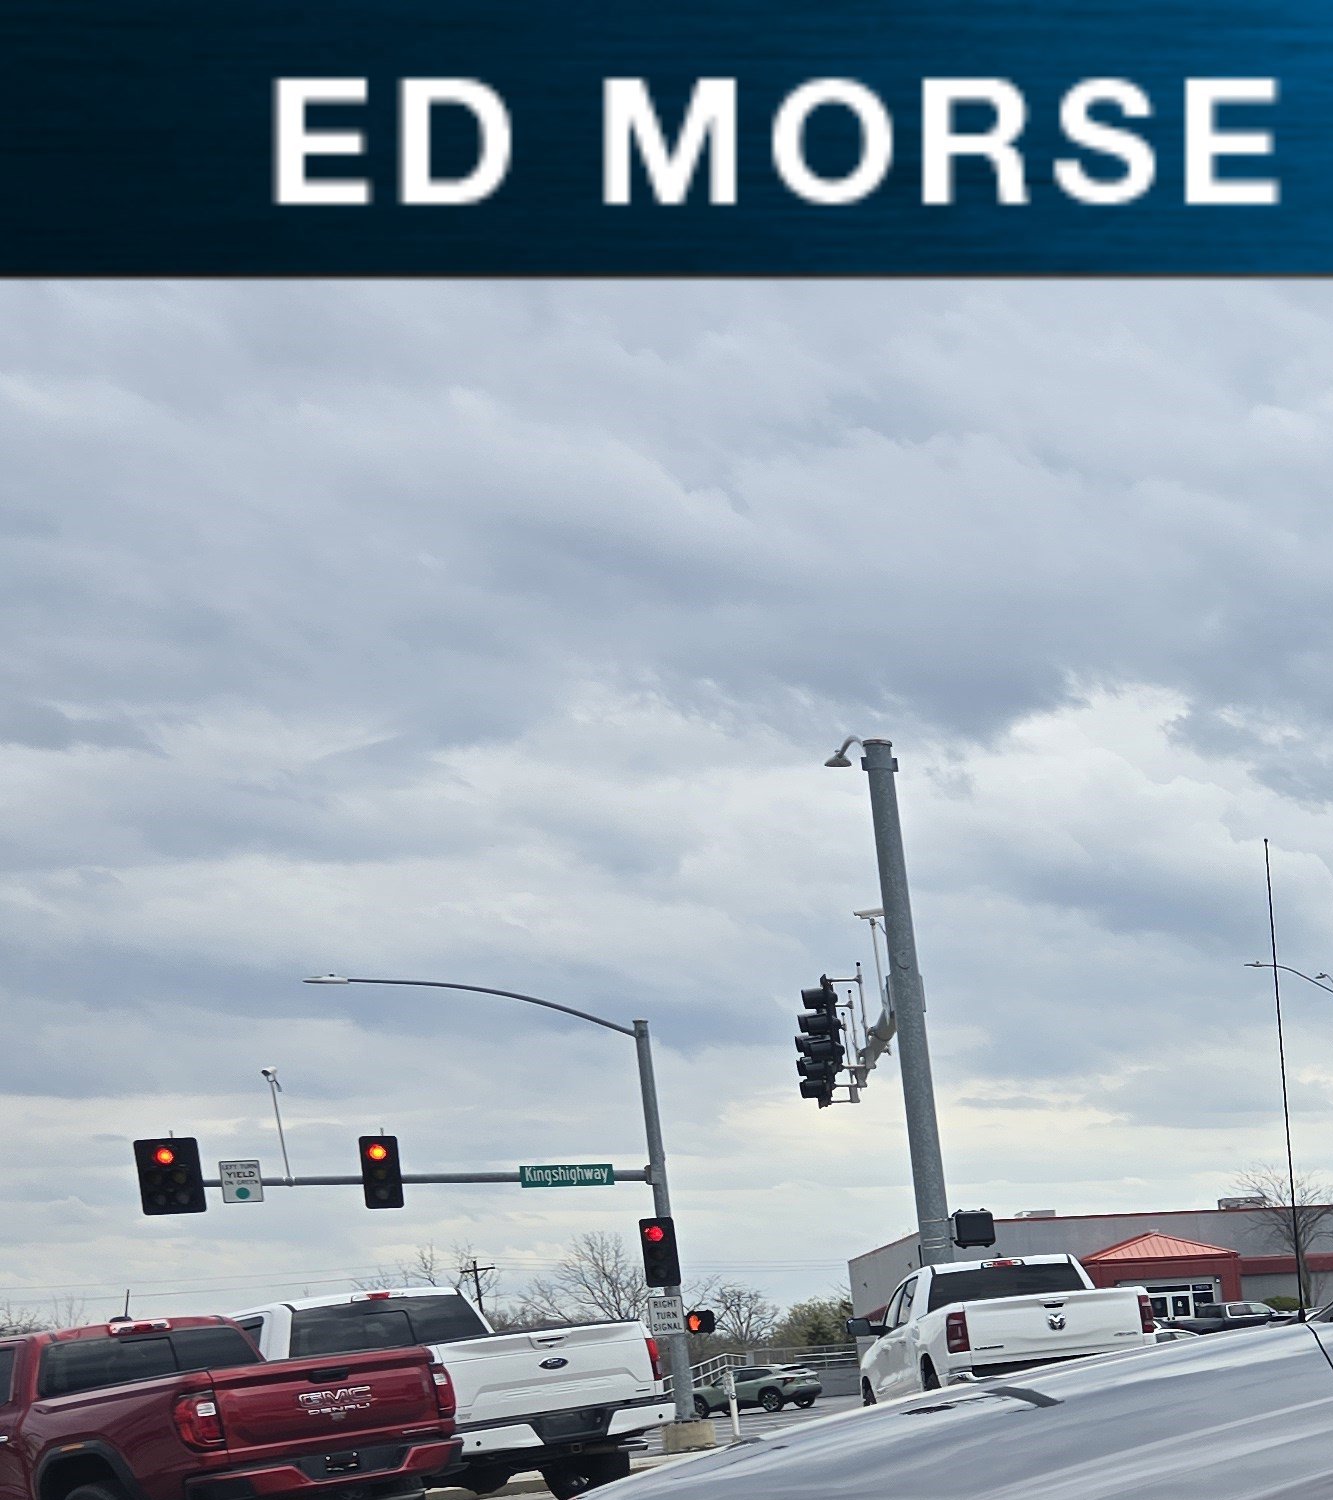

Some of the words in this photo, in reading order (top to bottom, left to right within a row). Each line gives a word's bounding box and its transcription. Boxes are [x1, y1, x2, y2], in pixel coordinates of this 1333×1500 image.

[226, 1170, 256, 1178] YIELD
[524, 1165, 609, 1186] Kingshighway
[653, 1299, 677, 1309] RIGHT
[656, 1311, 678, 1320] TURN
[653, 1322, 683, 1332] SIGNAL
[298, 1385, 372, 1409] GMC
